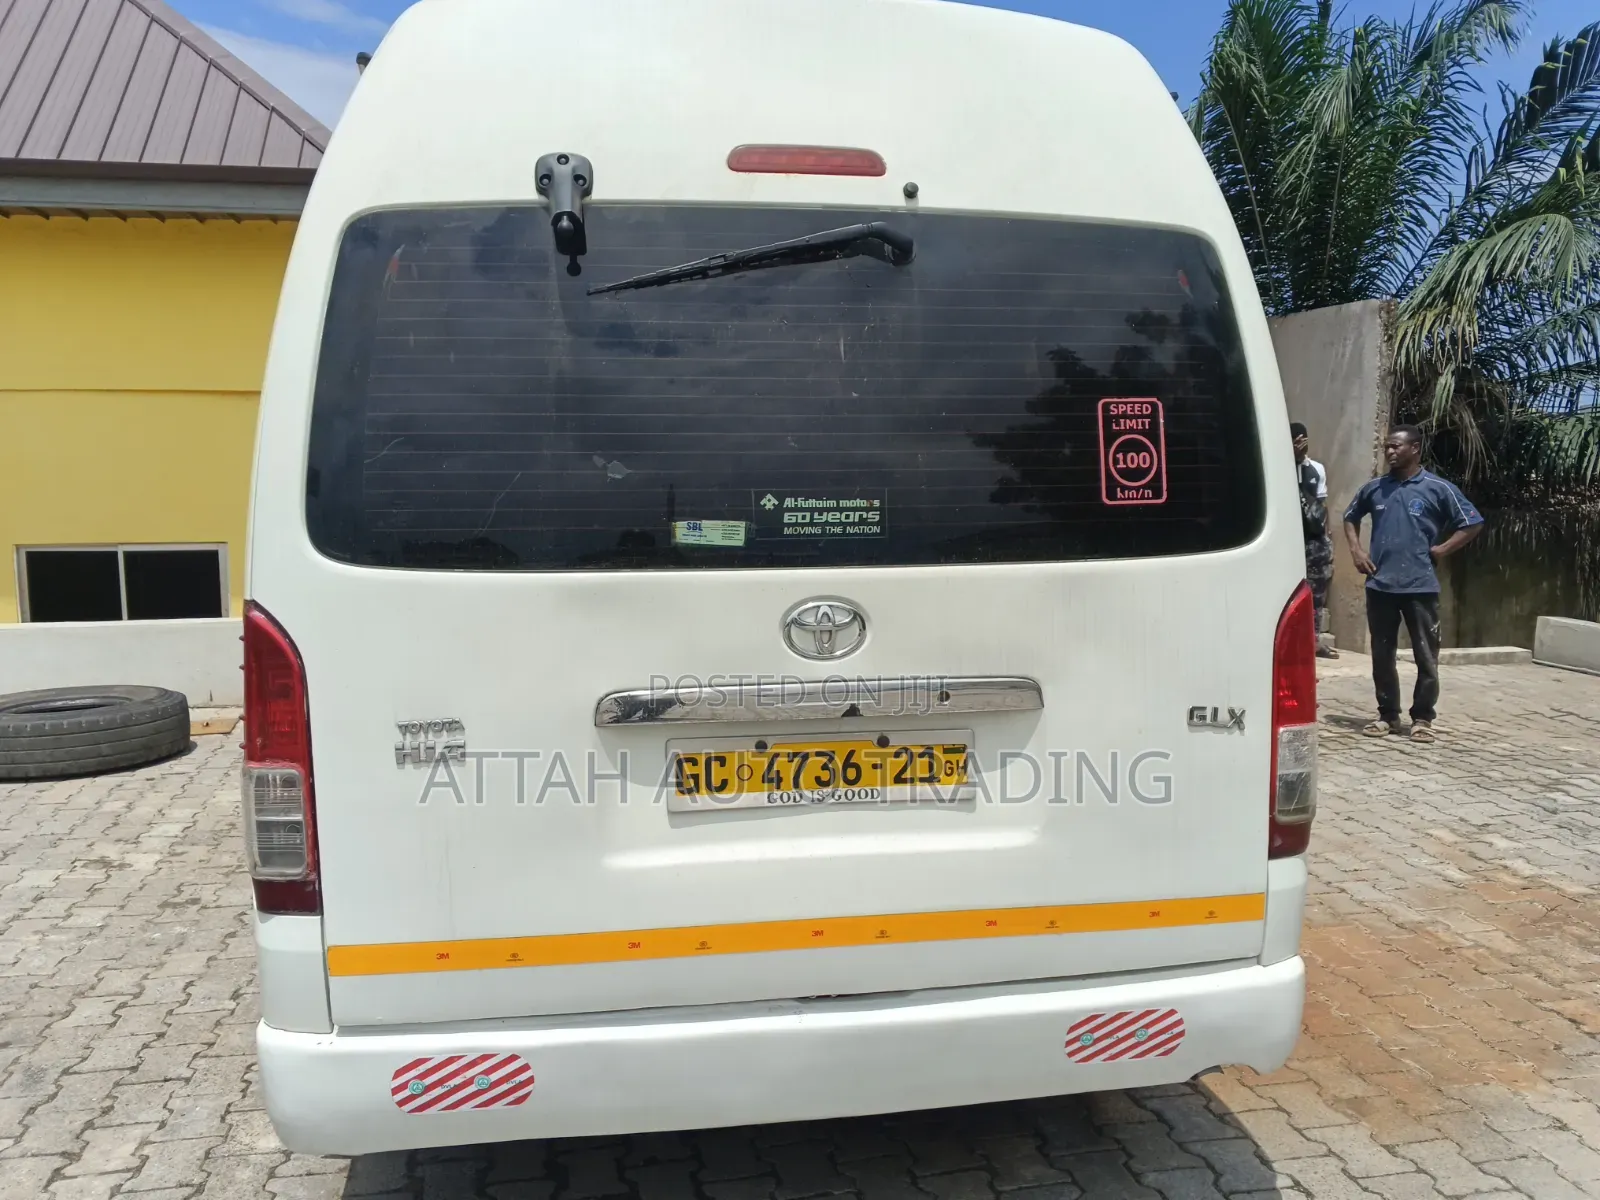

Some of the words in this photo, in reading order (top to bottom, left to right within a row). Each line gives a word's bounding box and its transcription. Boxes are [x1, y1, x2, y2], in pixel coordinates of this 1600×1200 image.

[1109, 403, 1152, 415] SPEED
[1112, 418, 1151, 430] LIMIT
[1116, 452, 1151, 469] 100
[783, 497, 837, 508] Al-Futtaim
[783, 511, 811, 524] 60
[813, 511, 880, 523] years
[686, 521, 704, 532] SBL
[783, 526, 822, 535] MOVING
[825, 525, 844, 534] THE
[846, 525, 881, 534] NATION
[1187, 705, 1246, 730] GLX
[397, 718, 466, 736] TOYOTA
[676, 756, 729, 795] GC
[767, 789, 804, 805] GOD
[811, 788, 827, 804] IS
[831, 787, 881, 803] GOOD
[1148, 910, 1161, 918] 3M
[985, 919, 998, 928] 3M
[811, 929, 824, 938] 3M
[627, 941, 641, 950] 3M
[436, 952, 450, 961] 3M
